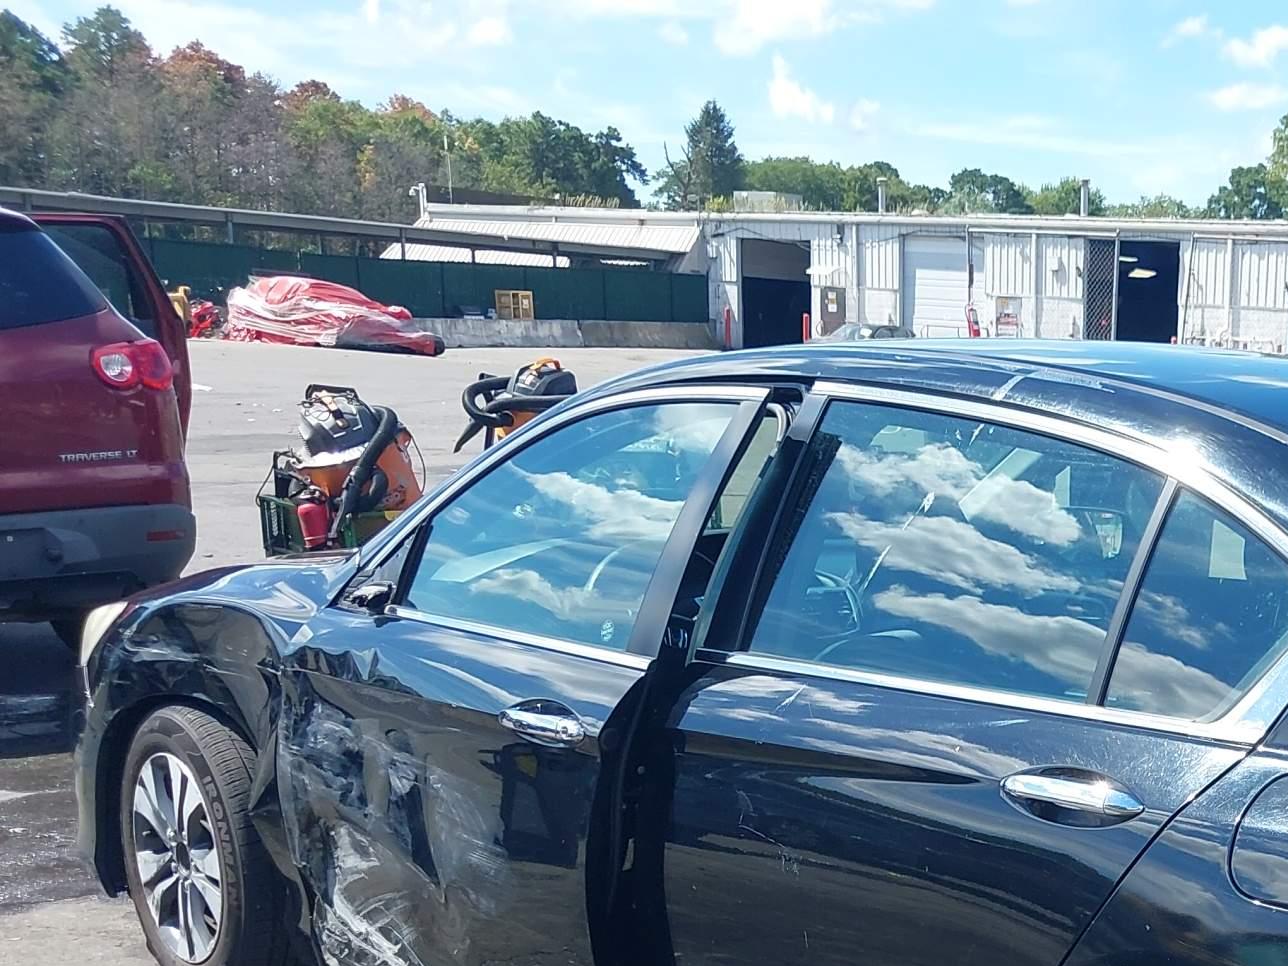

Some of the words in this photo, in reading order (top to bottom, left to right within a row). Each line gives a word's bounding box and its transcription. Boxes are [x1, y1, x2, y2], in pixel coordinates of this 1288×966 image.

[58, 450, 122, 462] TRAVERSE
[126, 449, 138, 458] LT
[202, 775, 240, 905] IRONMAN
